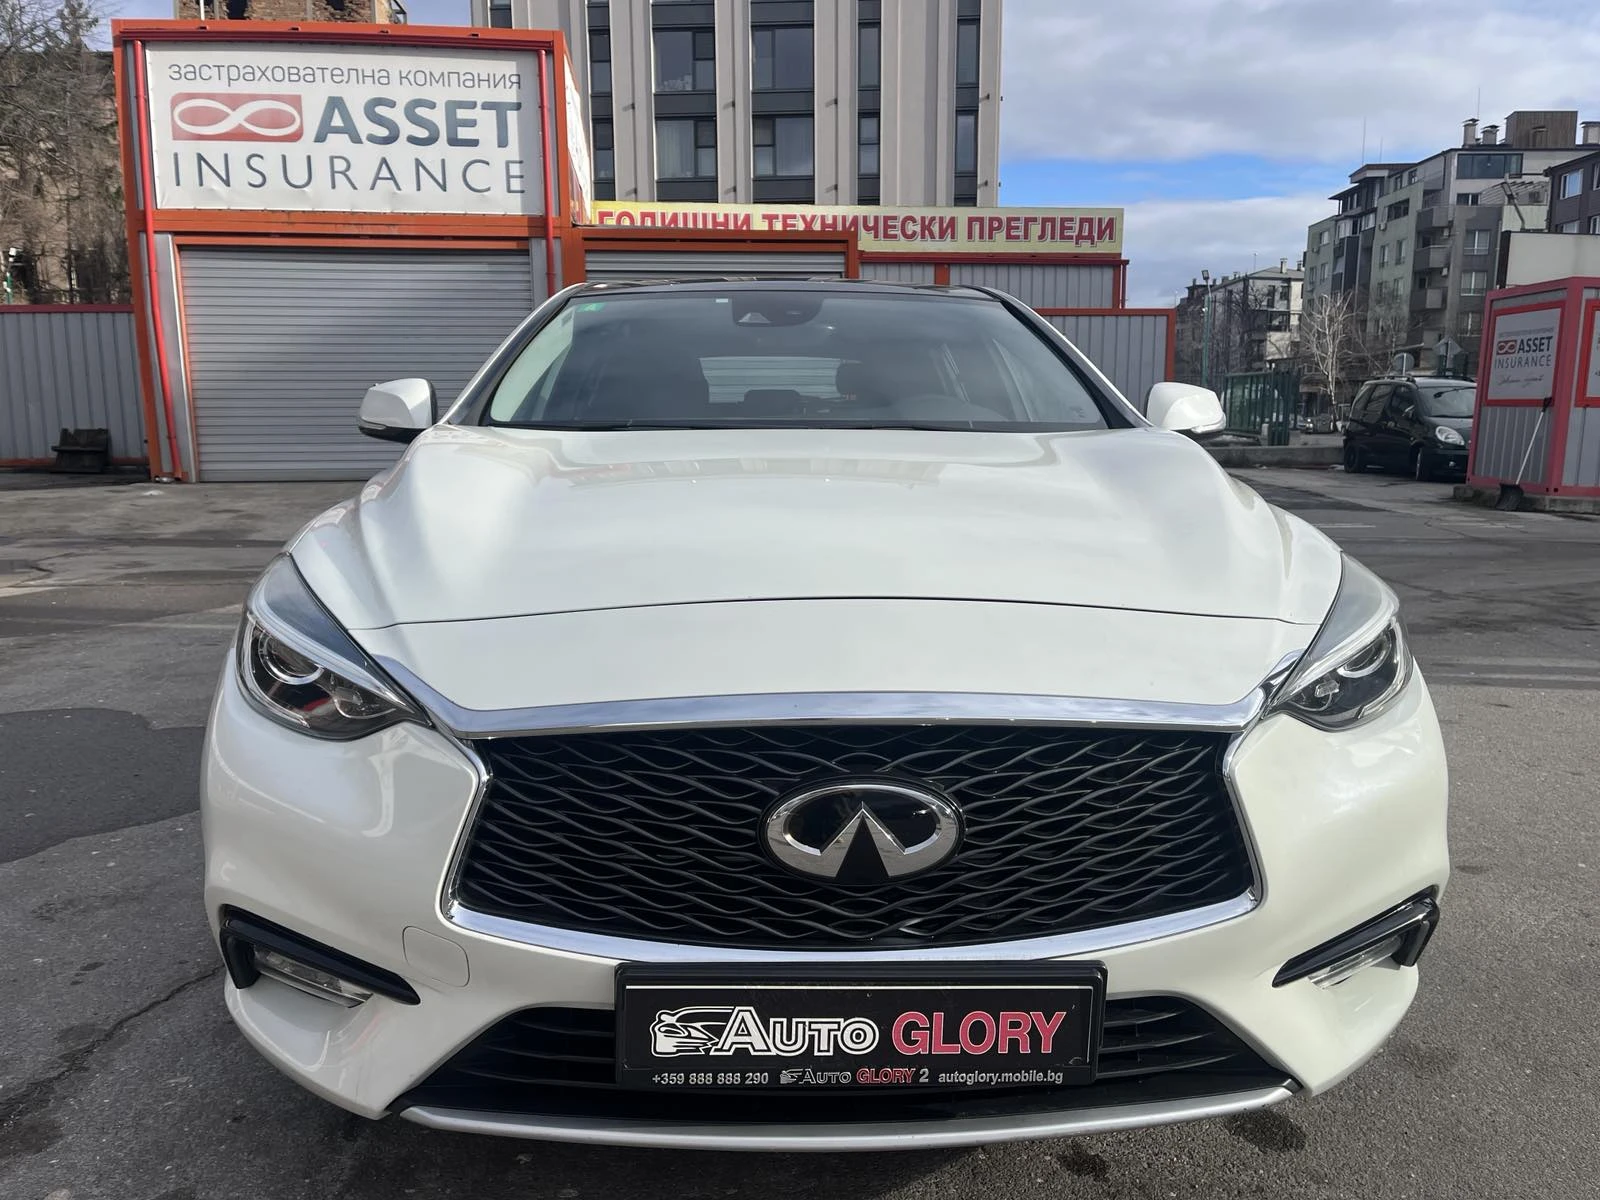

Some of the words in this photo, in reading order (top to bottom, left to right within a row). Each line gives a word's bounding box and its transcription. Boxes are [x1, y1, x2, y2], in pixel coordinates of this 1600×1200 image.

[168, 63, 391, 86] застрахователна
[399, 70, 521, 90] компания
[313, 96, 522, 148] ASSET
[173, 152, 526, 194] INSURANCE
[966, 217, 1117, 247] ПРЕГЛЕДИ
[1517, 336, 1552, 354] ASSET
[1495, 354, 1550, 369] INSURANCE
[891, 1011, 1066, 1055] GLORY
[651, 1072, 685, 1085] +359
[688, 1072, 713, 1085] 888
[716, 1072, 741, 1085] 888
[744, 1072, 769, 1085] 290
[856, 1068, 915, 1084] GLORY
[918, 1068, 929, 1083] 2
[938, 1069, 1064, 1085] autoglory.mobile.bg
